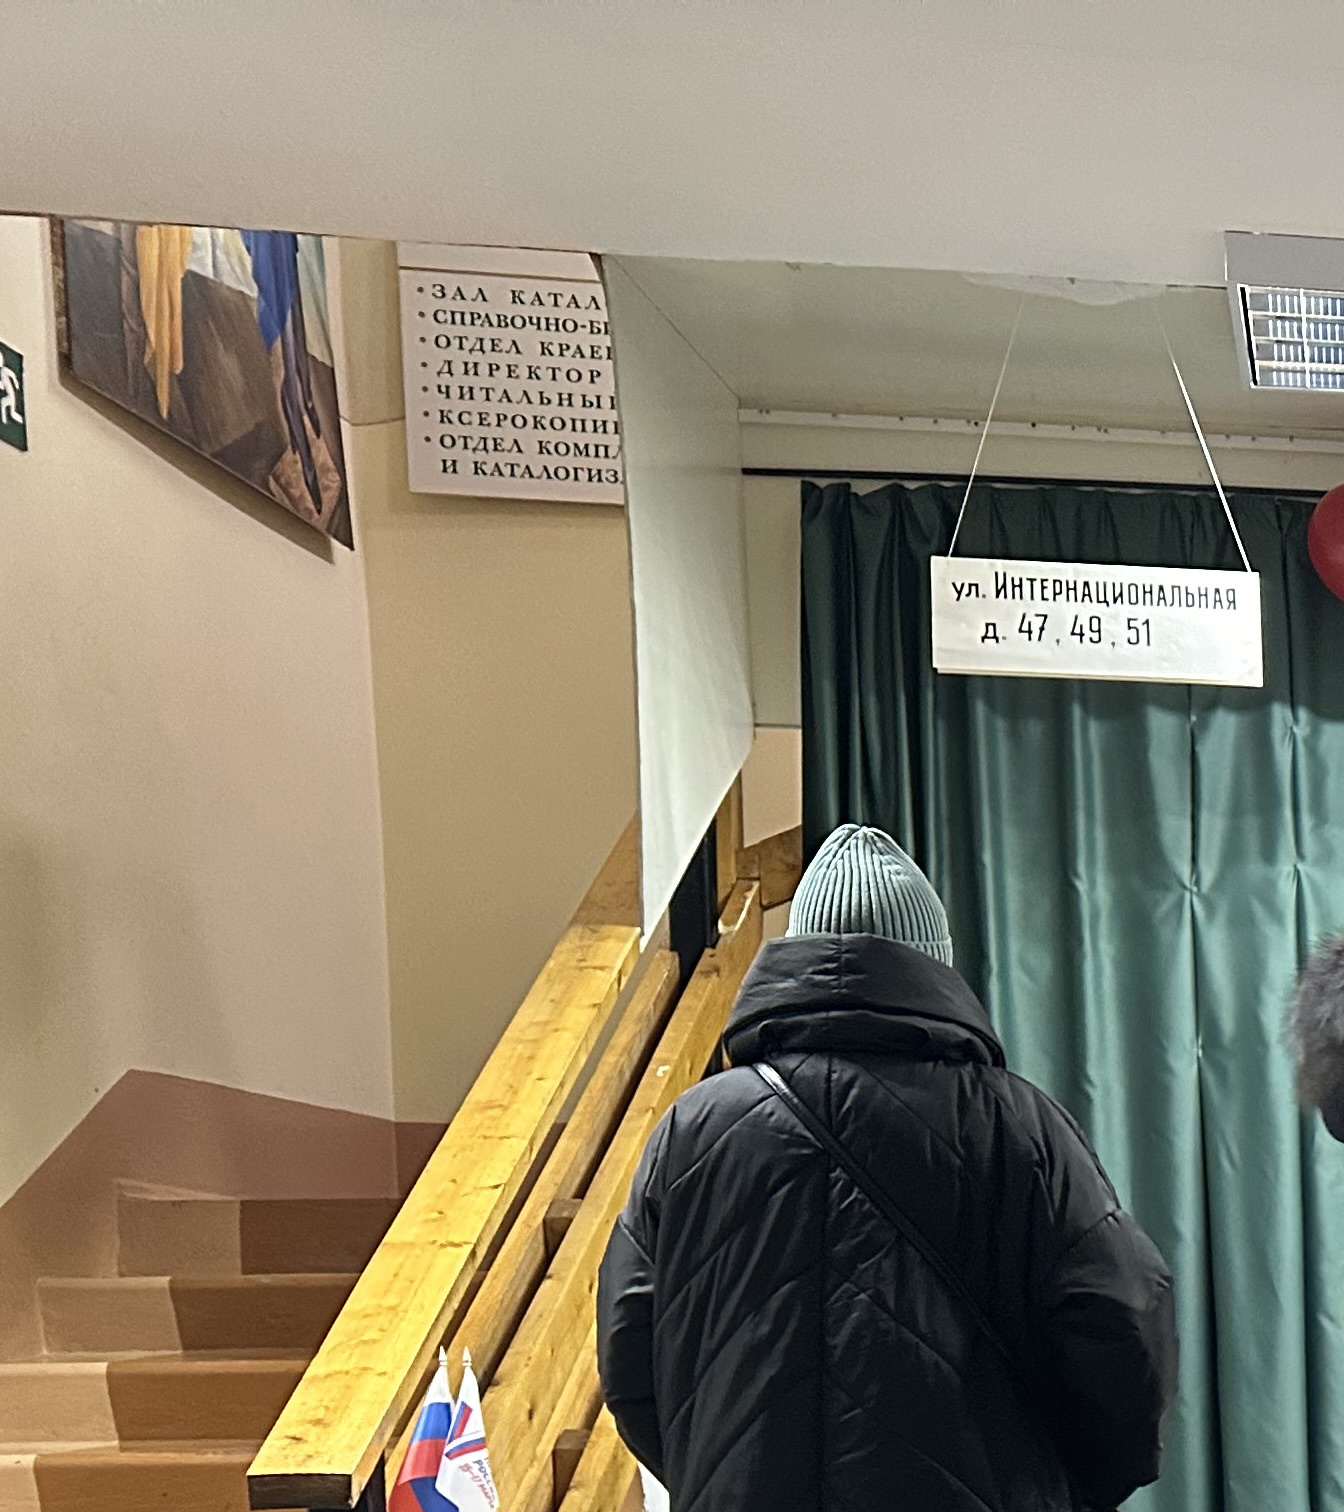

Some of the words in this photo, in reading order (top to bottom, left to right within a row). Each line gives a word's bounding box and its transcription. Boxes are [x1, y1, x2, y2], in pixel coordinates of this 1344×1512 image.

[431, 283, 488, 303] ЗАЛ
[434, 333, 523, 355] ОТДЕЛ
[436, 359, 602, 384] ДИРЕКТОР
[439, 433, 524, 454] ОТДЕЛ
[441, 458, 459, 475] И
[472, 460, 624, 485] КАТАЛОГИЗ
[951, 580, 987, 603] ул.
[980, 621, 1008, 644] д.
[1126, 617, 1152, 647] 51
